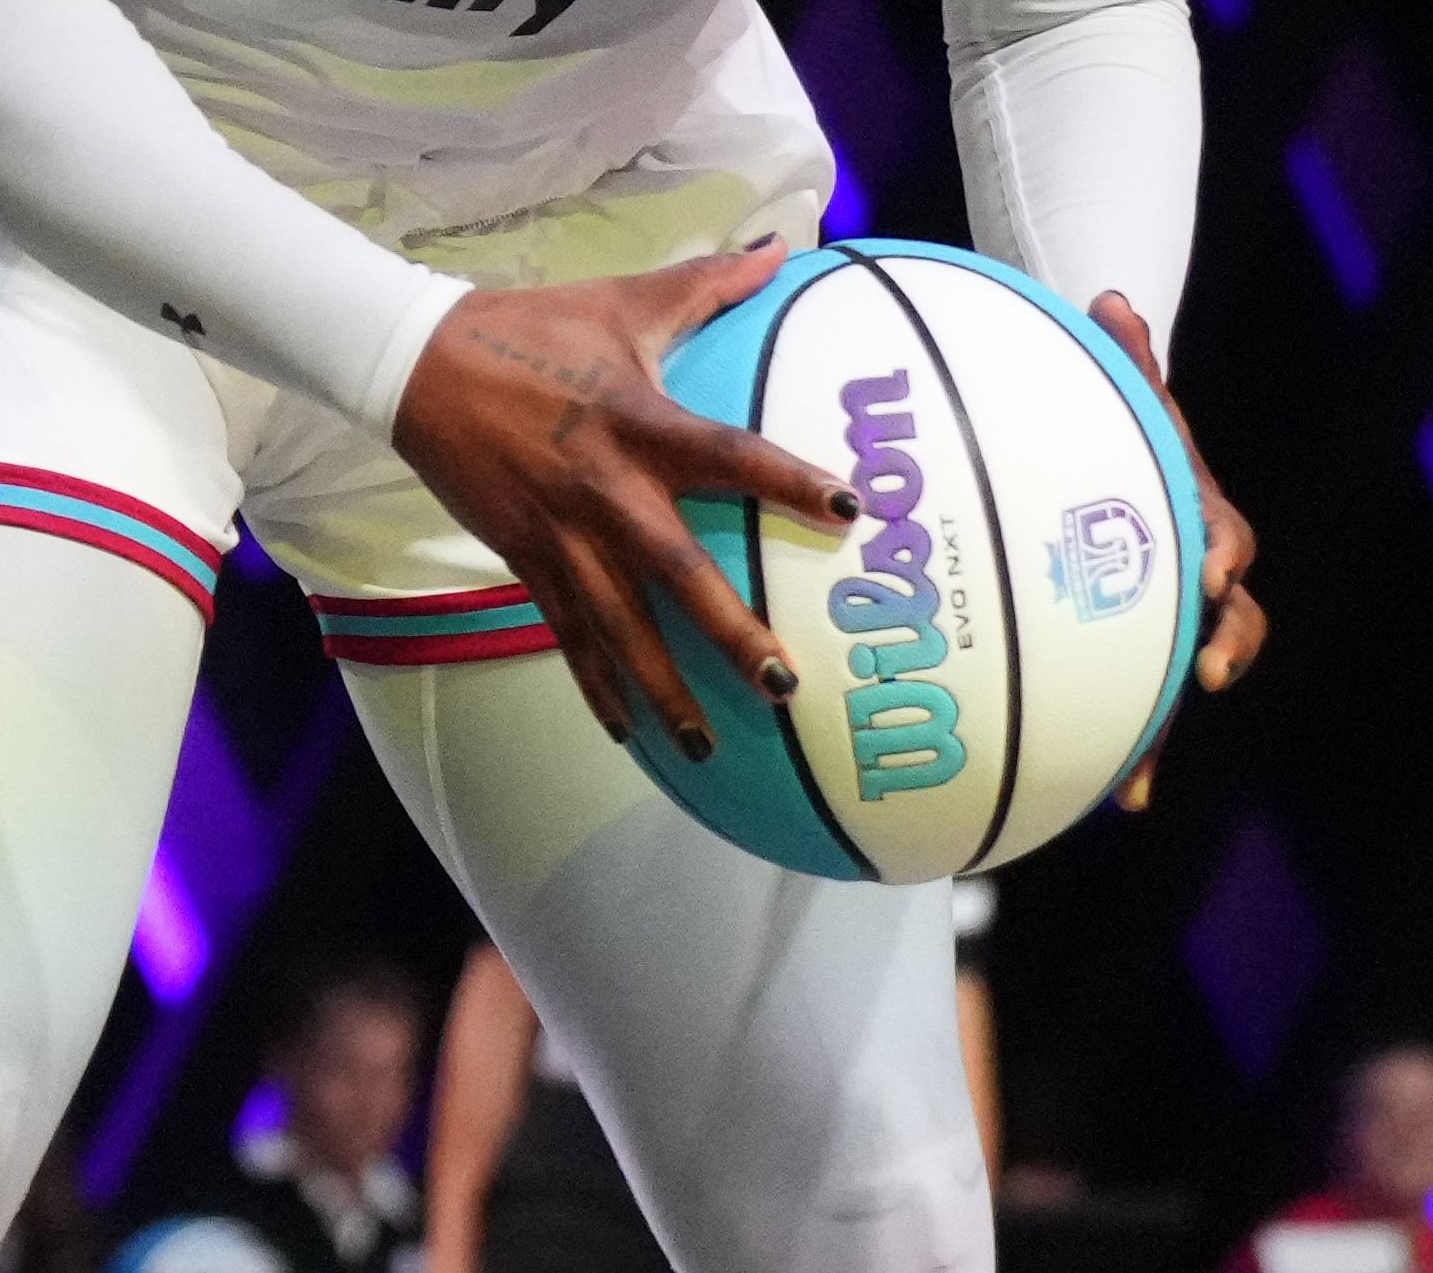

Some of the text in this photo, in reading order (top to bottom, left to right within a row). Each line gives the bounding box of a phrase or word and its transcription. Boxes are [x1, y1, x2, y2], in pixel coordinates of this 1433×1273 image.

[827, 368, 967, 802] Wilson
[939, 513, 973, 650] EVO NXT
